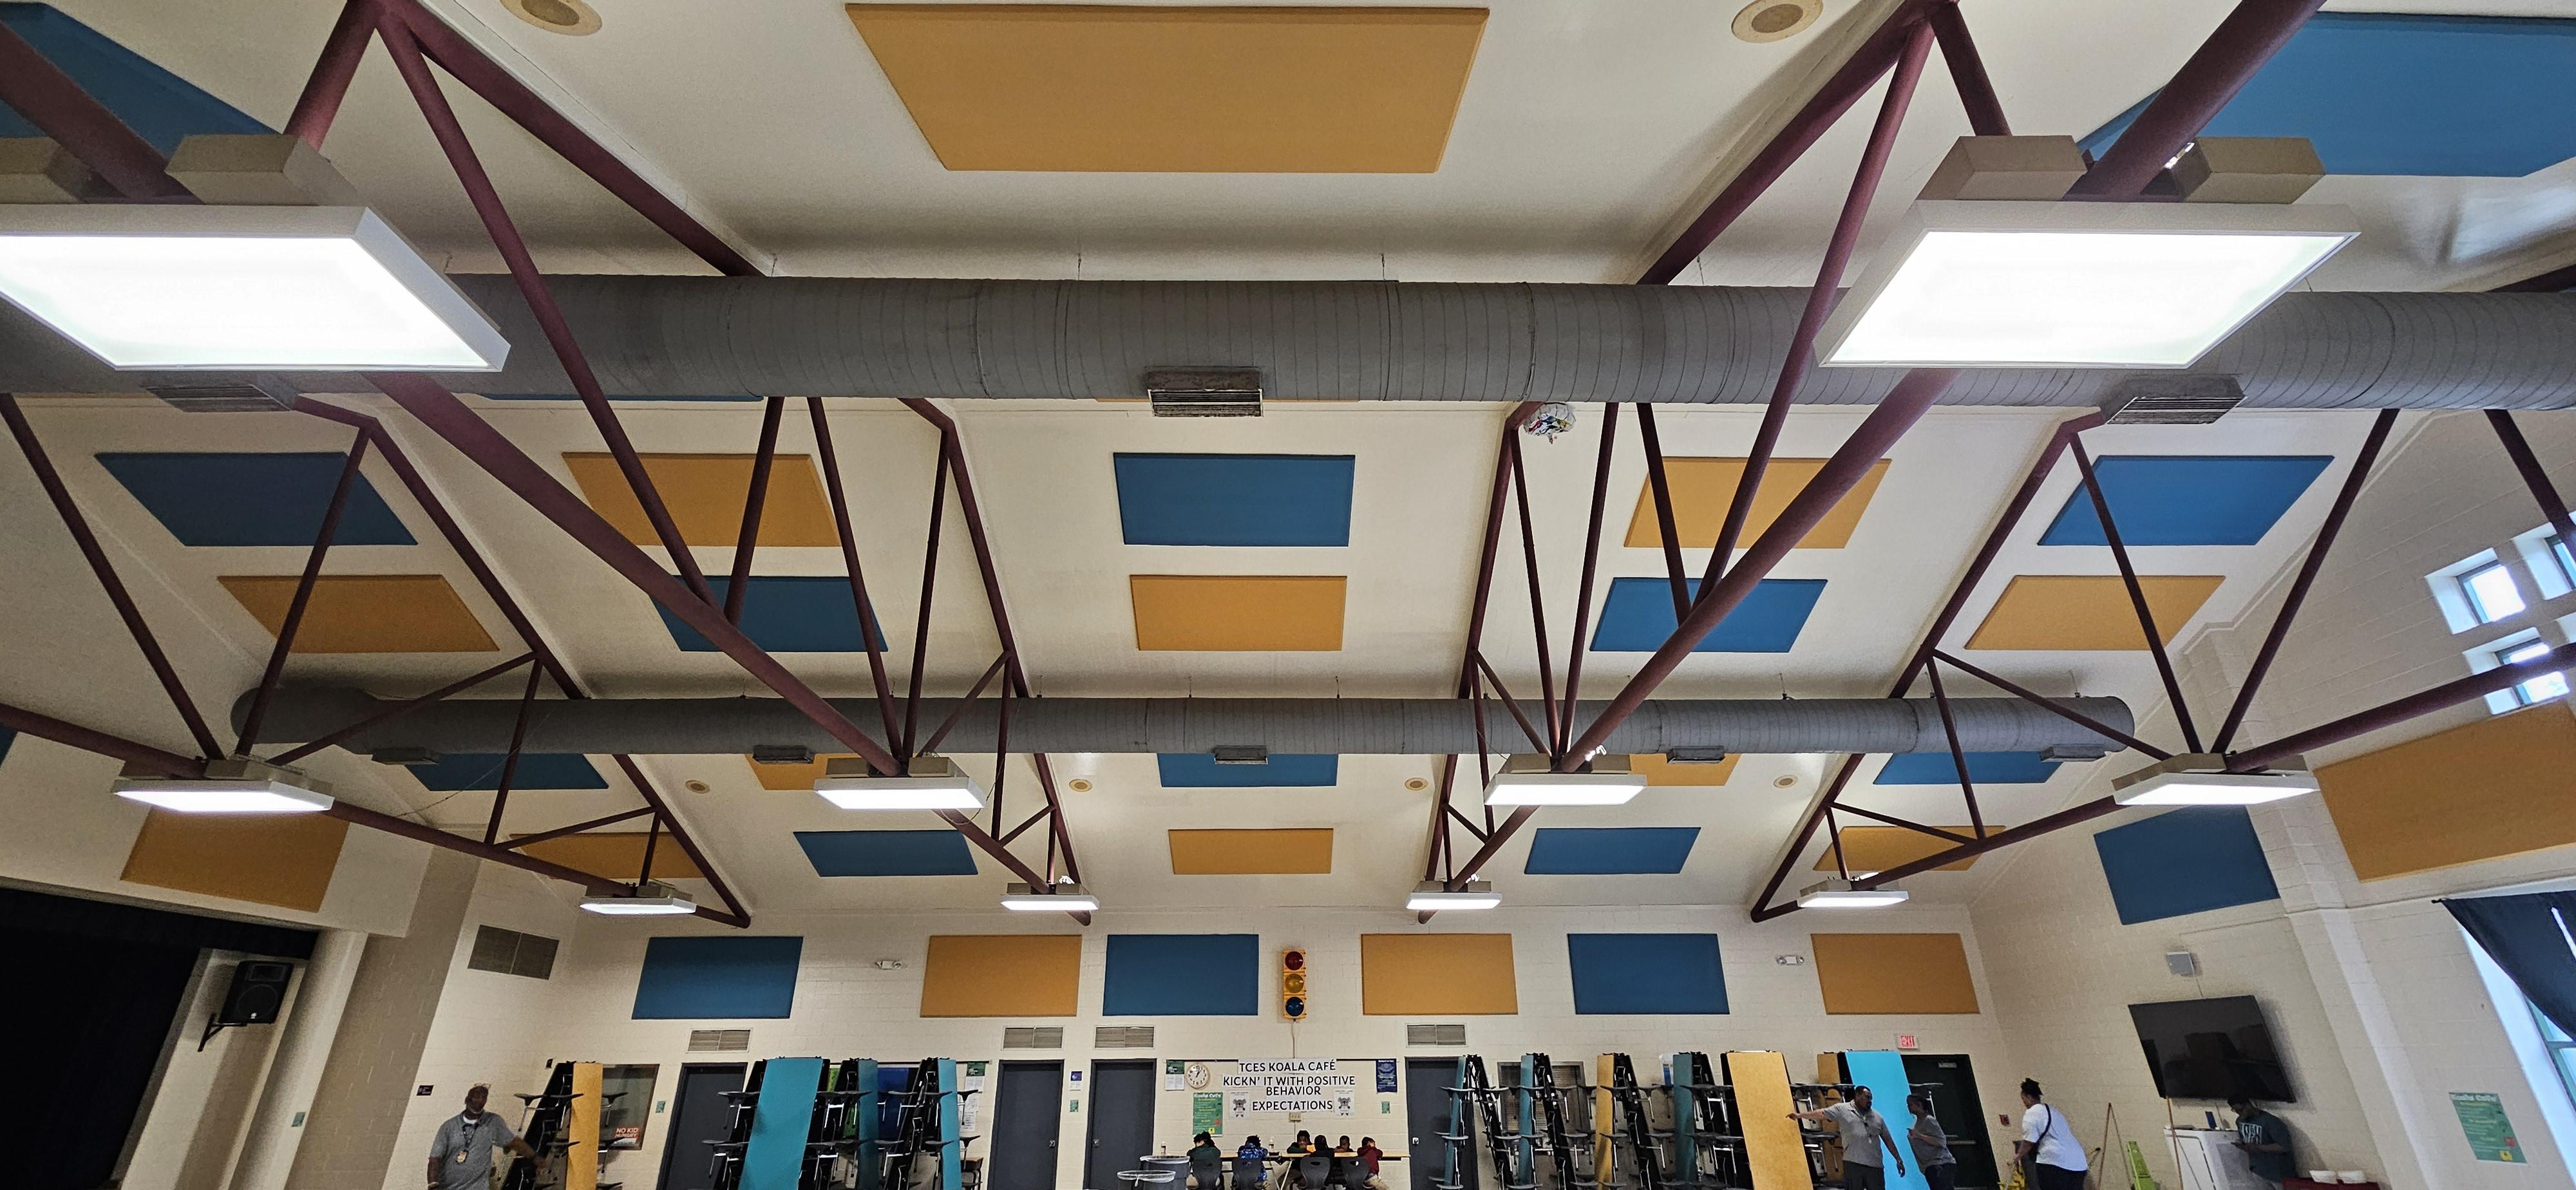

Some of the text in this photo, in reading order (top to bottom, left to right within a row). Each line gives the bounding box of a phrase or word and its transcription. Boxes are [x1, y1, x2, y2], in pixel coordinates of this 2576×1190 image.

[1900, 1035, 1915, 1046] EXIT
[1239, 1059, 1336, 1072] TCES KOALA CAFÉ
[1264, 1076, 1273, 1086] IT
[1275, 1076, 1303, 1086] WITH
[1307, 1076, 1356, 1085] POSITIVE
[1266, 1086, 1321, 1095] BEHAVIOR
[1252, 1100, 1333, 1111] EXPECTATIONS
